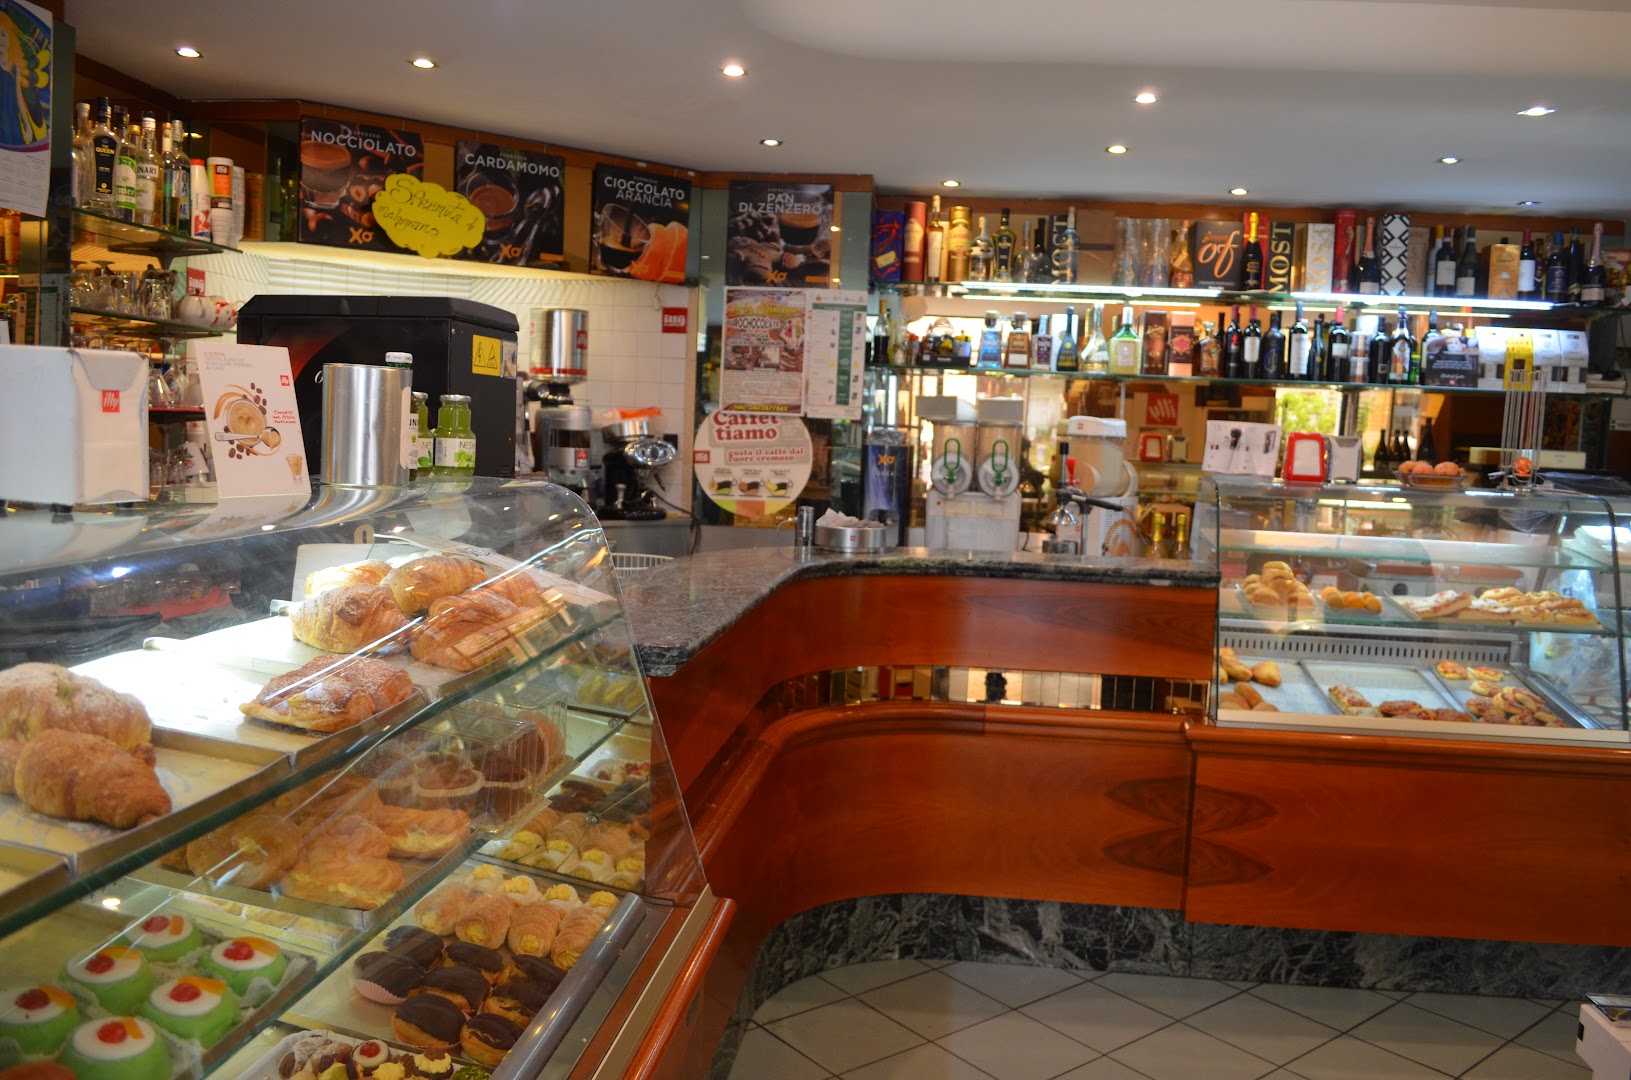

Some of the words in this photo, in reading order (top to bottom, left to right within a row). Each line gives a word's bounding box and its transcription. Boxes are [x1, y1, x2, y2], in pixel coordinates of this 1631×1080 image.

[310, 129, 417, 158] NOCCIOLATO
[464, 152, 561, 179] CARDAMOMO
[603, 176, 686, 201] CIOCCOLATO
[767, 193, 795, 204] PAN
[615, 189, 673, 209] ARANCIA
[739, 201, 754, 213] DI
[757, 201, 822, 215] ZENZERO
[1268, 221, 1292, 294] MOST
[103, 391, 120, 411] illy
[715, 426, 778, 441] tiamo
[728, 449, 753, 458] gusta
[755, 448, 762, 456] il
[765, 448, 787, 456] caffè
[789, 447, 804, 455] dal
[728, 455, 754, 463] cuore
